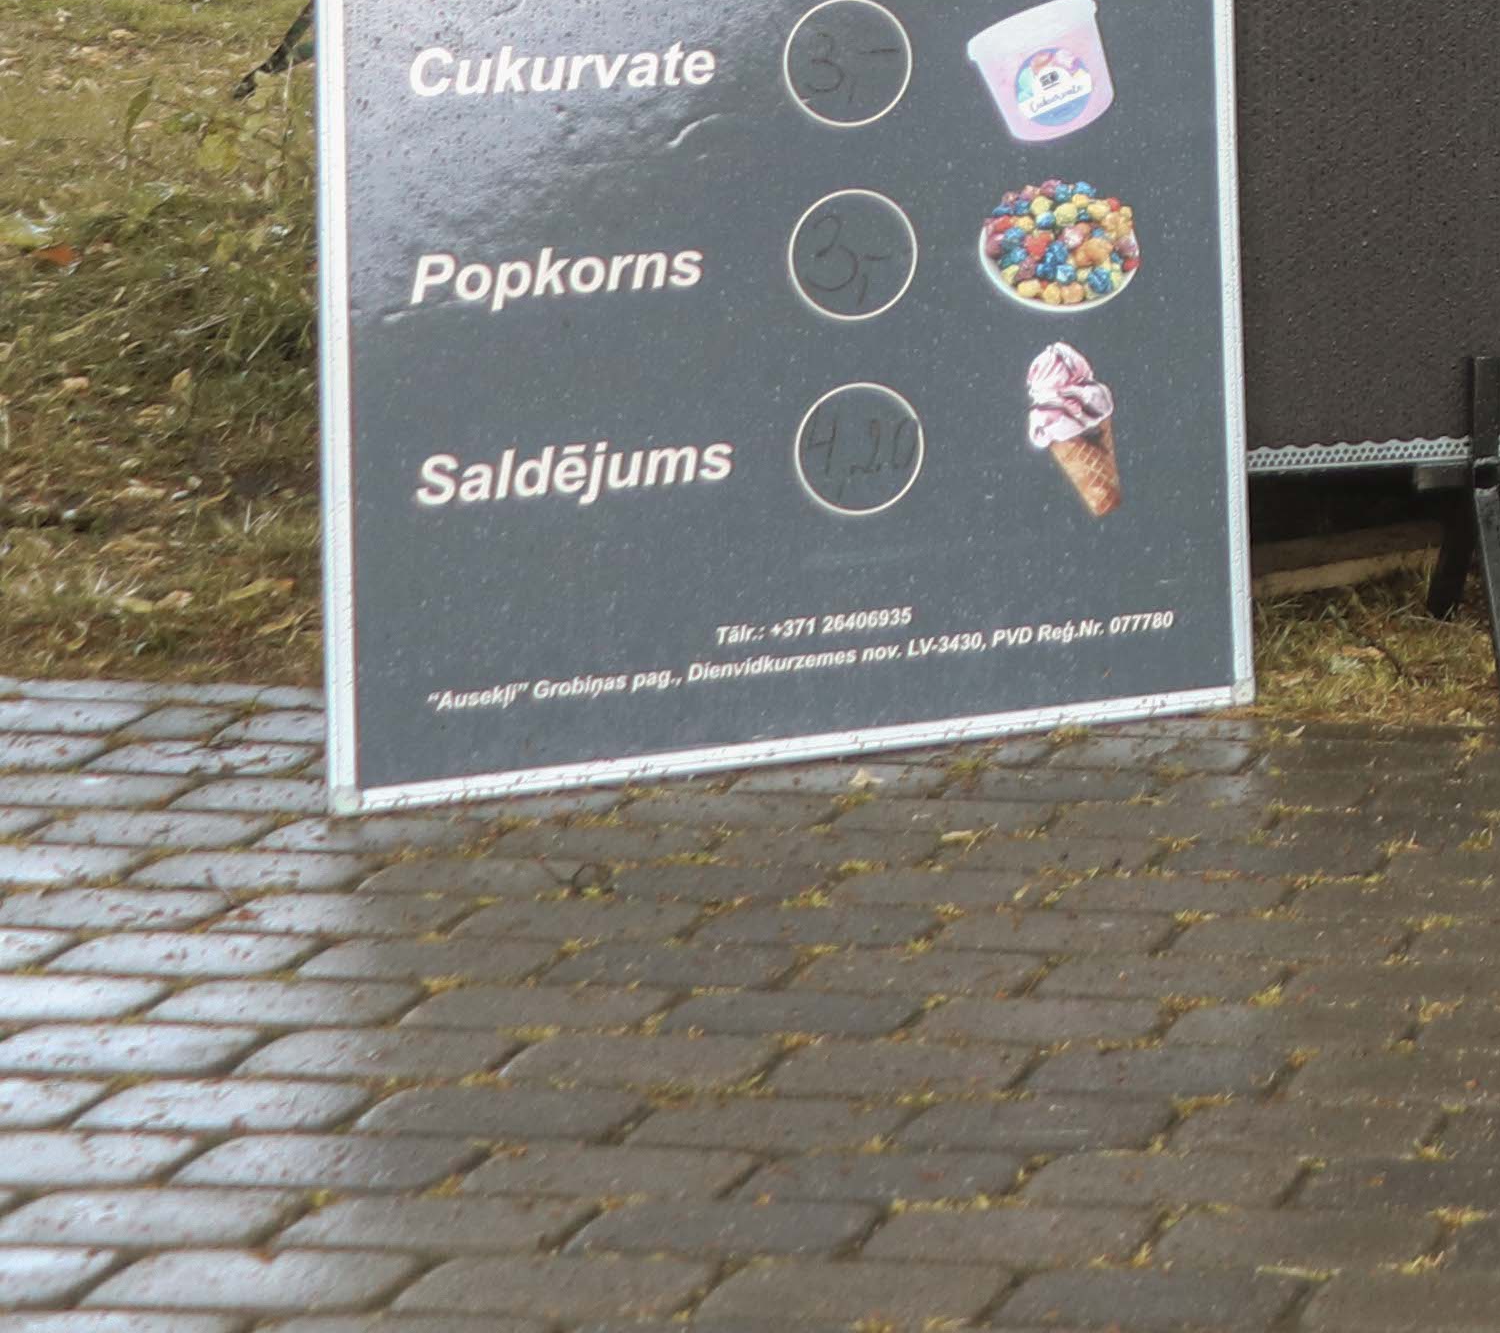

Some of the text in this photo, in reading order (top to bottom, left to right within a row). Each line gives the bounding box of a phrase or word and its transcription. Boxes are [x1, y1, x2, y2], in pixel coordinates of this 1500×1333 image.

[409, 38, 717, 97] Cukurvate
[409, 246, 704, 313] Popkorns
[416, 440, 735, 506] Saldējums
[532, 674, 627, 702] Grobiņas
[687, 647, 858, 683] Dienvidkurzemes
[861, 646, 902, 663] nov.
[907, 633, 988, 659] LV-3430,
[992, 627, 1034, 649] PVD
[1109, 611, 1175, 635] 077780
[716, 606, 914, 646] Tālr.: +371 26406935
